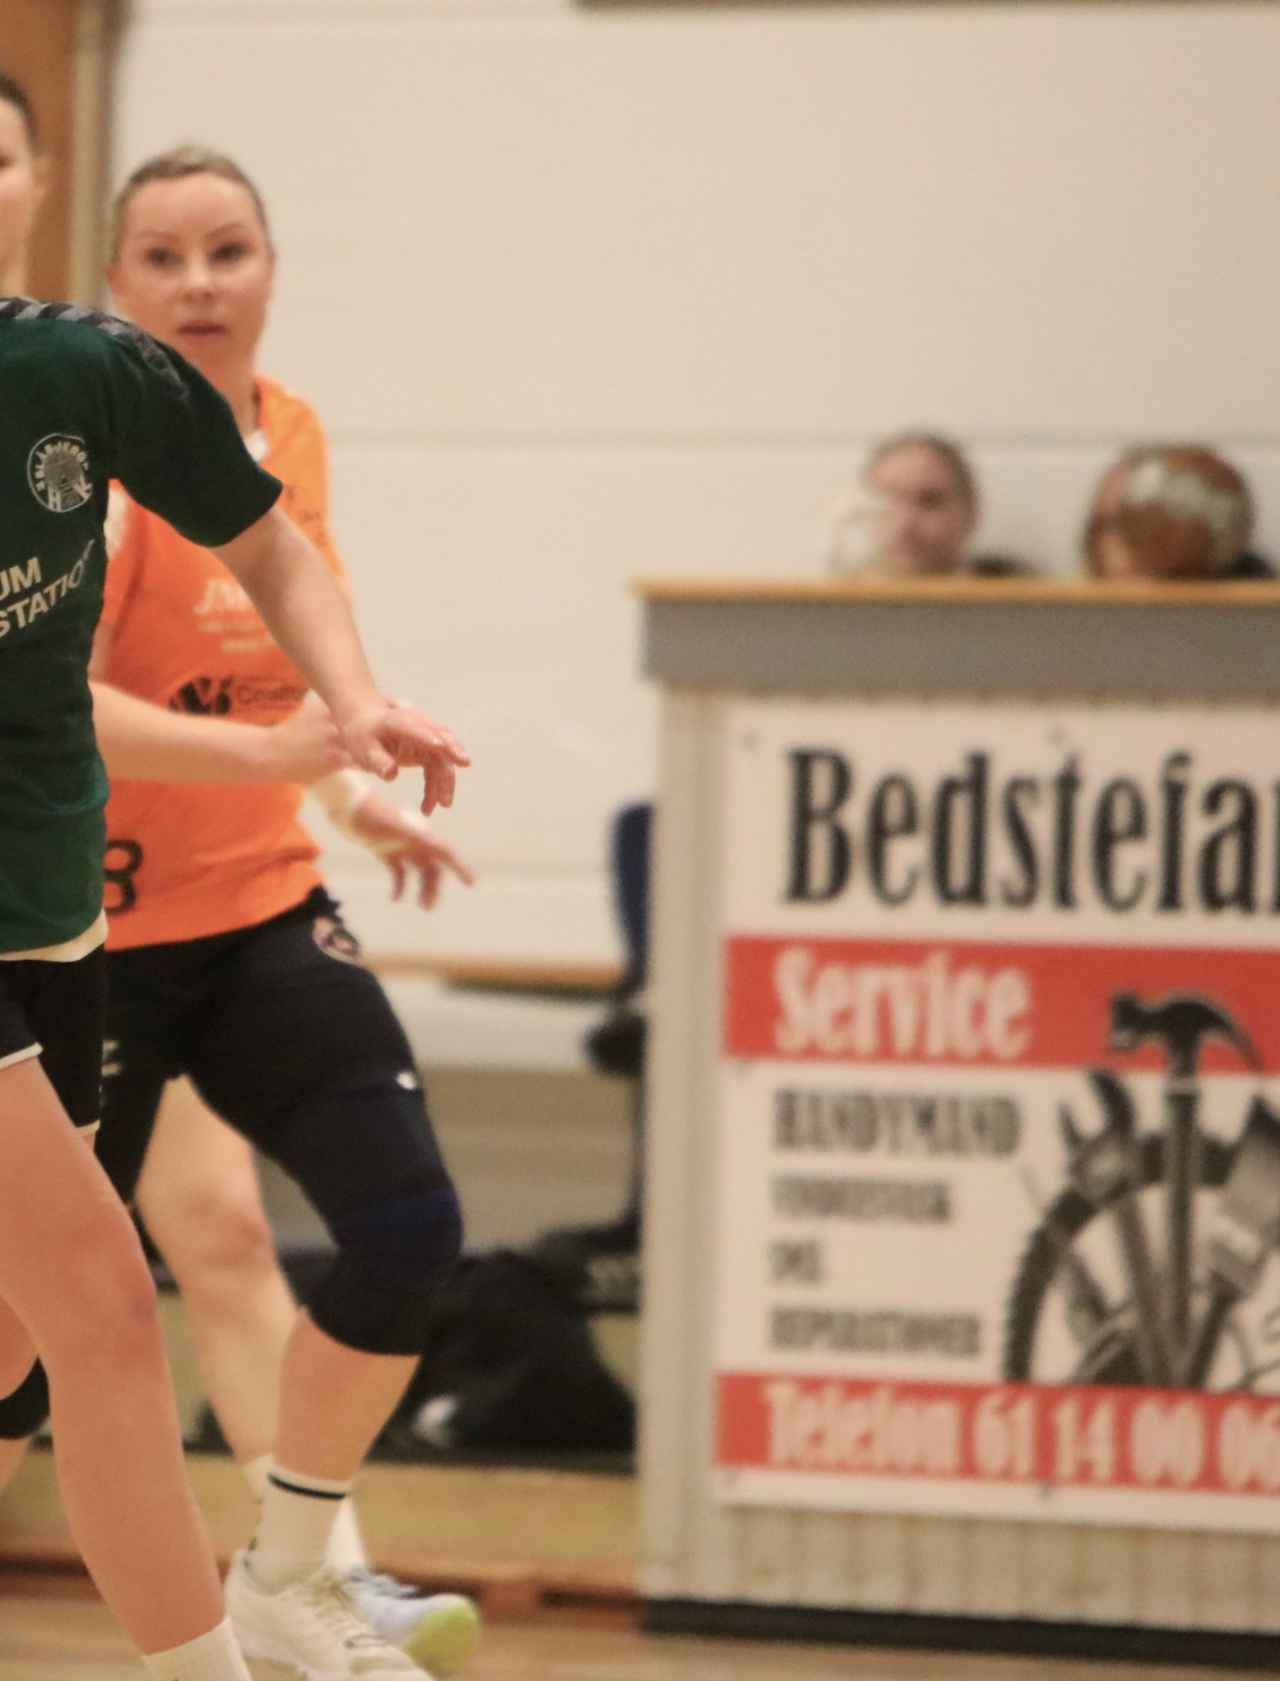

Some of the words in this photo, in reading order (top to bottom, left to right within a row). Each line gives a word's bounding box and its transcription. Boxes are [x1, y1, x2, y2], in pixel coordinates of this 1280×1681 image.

[783, 746, 1280, 913] Bedstefa
[773, 944, 1032, 1060] Service
[764, 1381, 961, 1475] Telefon
[973, 1390, 1036, 1480] 61
